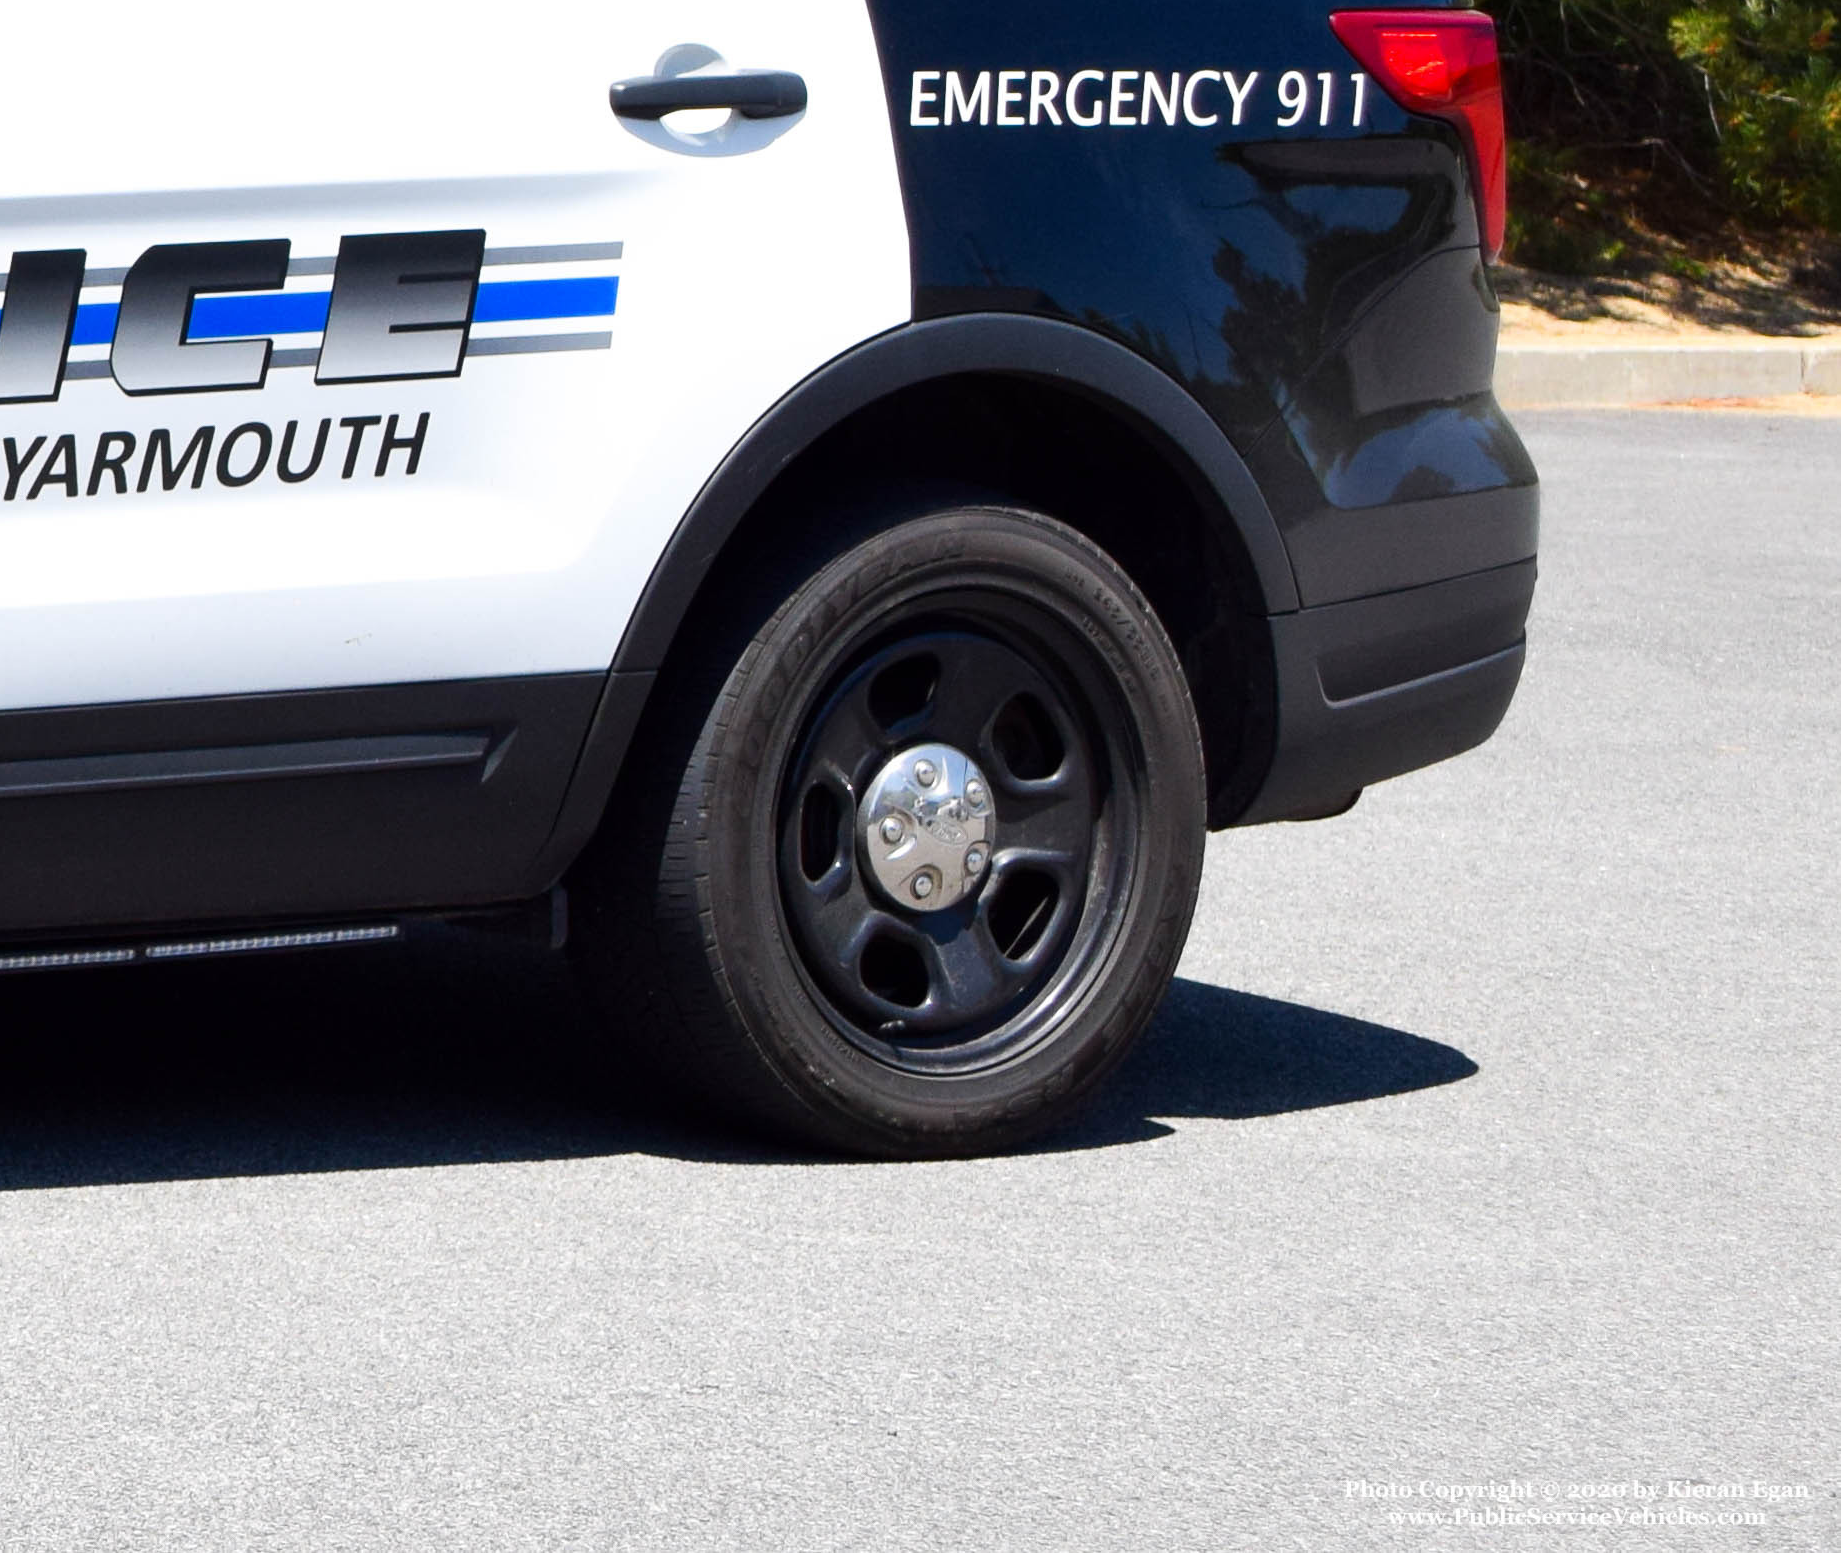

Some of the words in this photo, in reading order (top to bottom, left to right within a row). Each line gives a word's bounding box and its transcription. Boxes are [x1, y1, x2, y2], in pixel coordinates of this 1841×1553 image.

[910, 69, 1259, 127] EMERGENCY
[1277, 69, 1367, 127] 911
[0, 412, 430, 503] YARMOUTH
